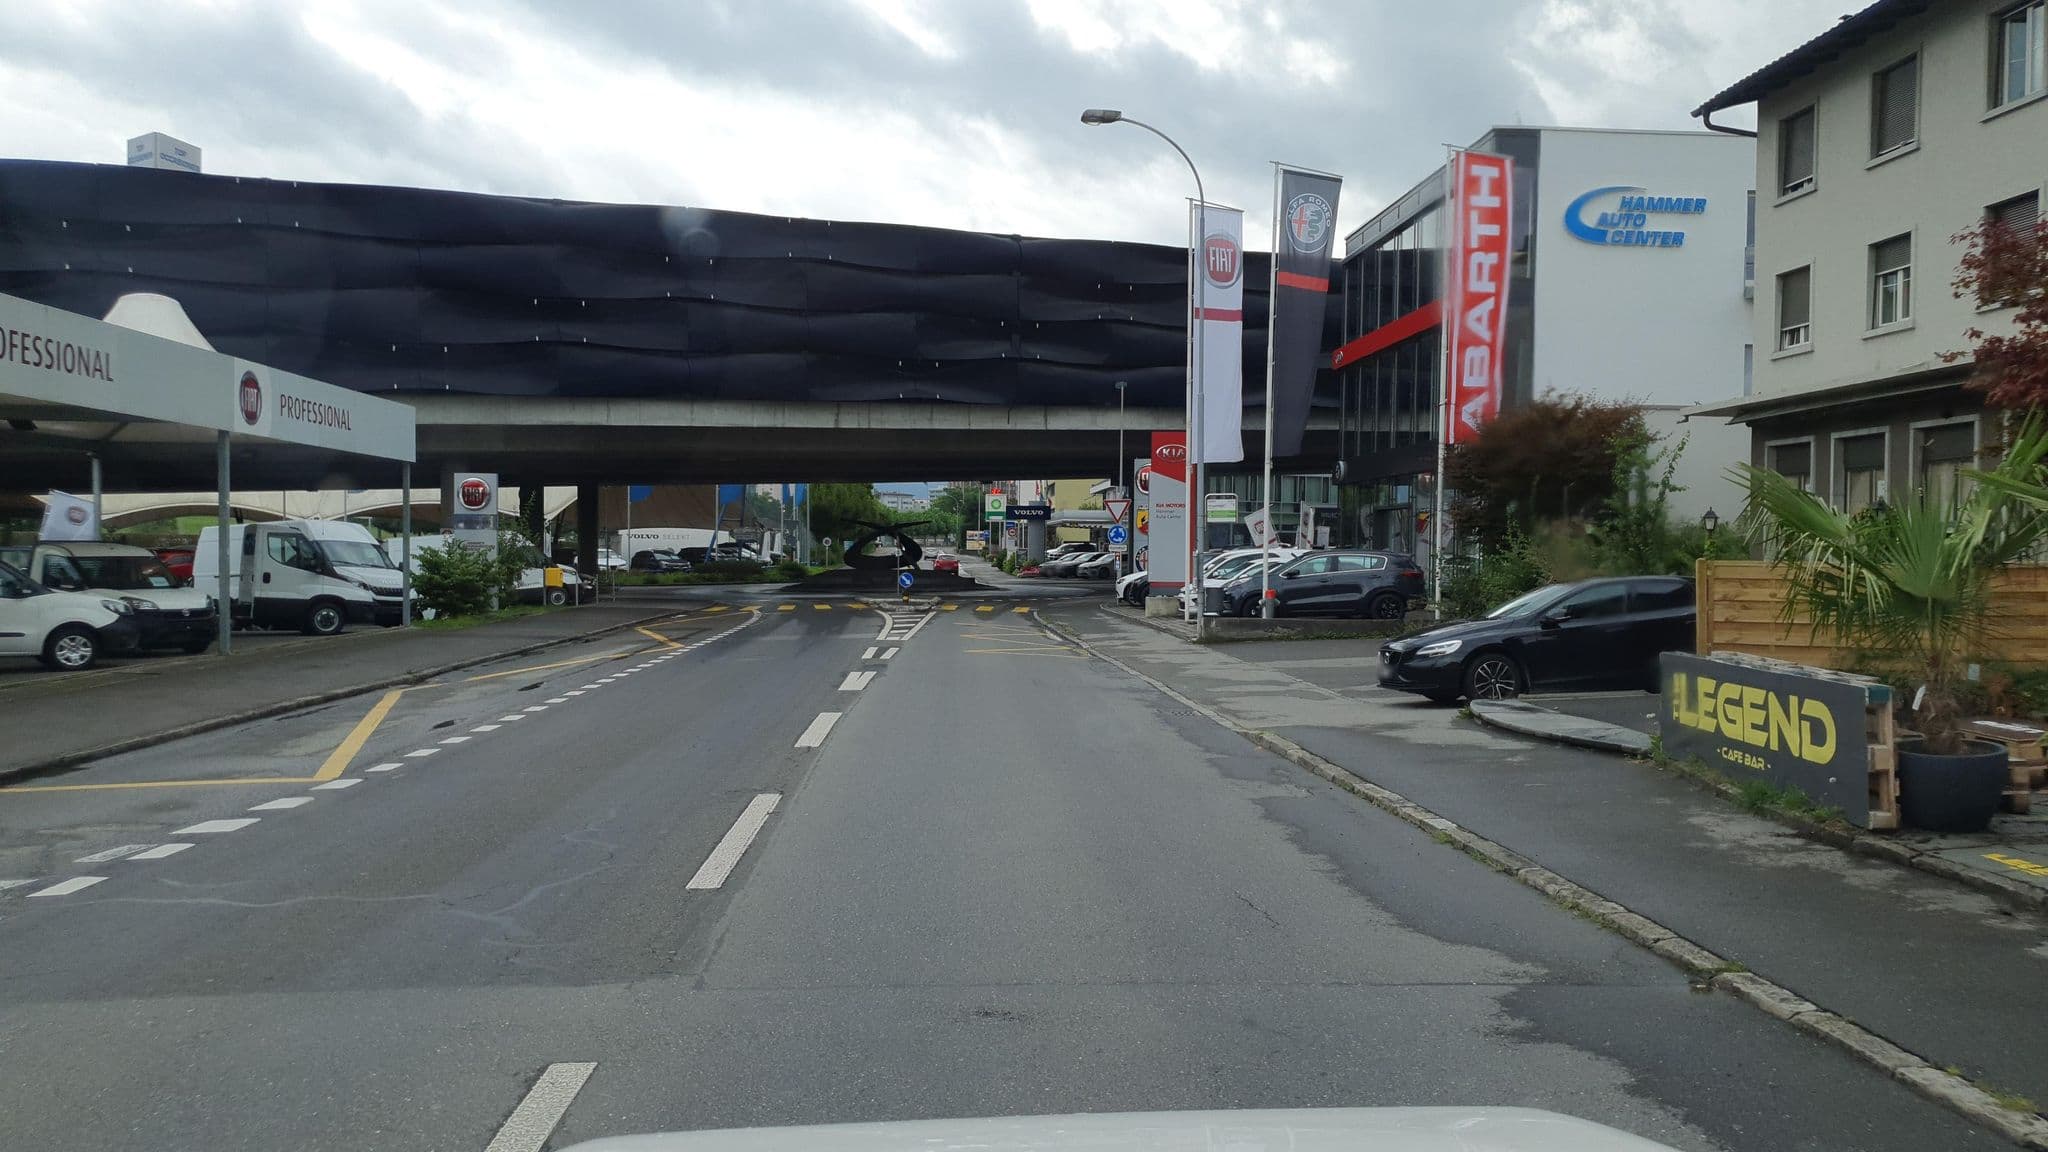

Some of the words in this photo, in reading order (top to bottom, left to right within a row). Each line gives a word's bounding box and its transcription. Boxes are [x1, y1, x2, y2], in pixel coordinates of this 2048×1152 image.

[1288, 198, 1305, 220] ALFA
[1308, 196, 1332, 228] ROMEO
[1619, 195, 1707, 214] HAMMER
[1596, 212, 1647, 228] AUTO
[1611, 229, 1685, 247] CENTER
[1209, 246, 1234, 273] FIAT
[1461, 164, 1500, 434] ABARTH
[244, 387, 258, 412] FIAT
[280, 393, 352, 431] PROFESSIONAL
[1162, 447, 1185, 458] KIA
[464, 486, 484, 502] FIAT
[1679, 672, 1837, 765] LEGEND
[1721, 747, 1743, 764] CAFE
[1744, 755, 1765, 771] BAR
